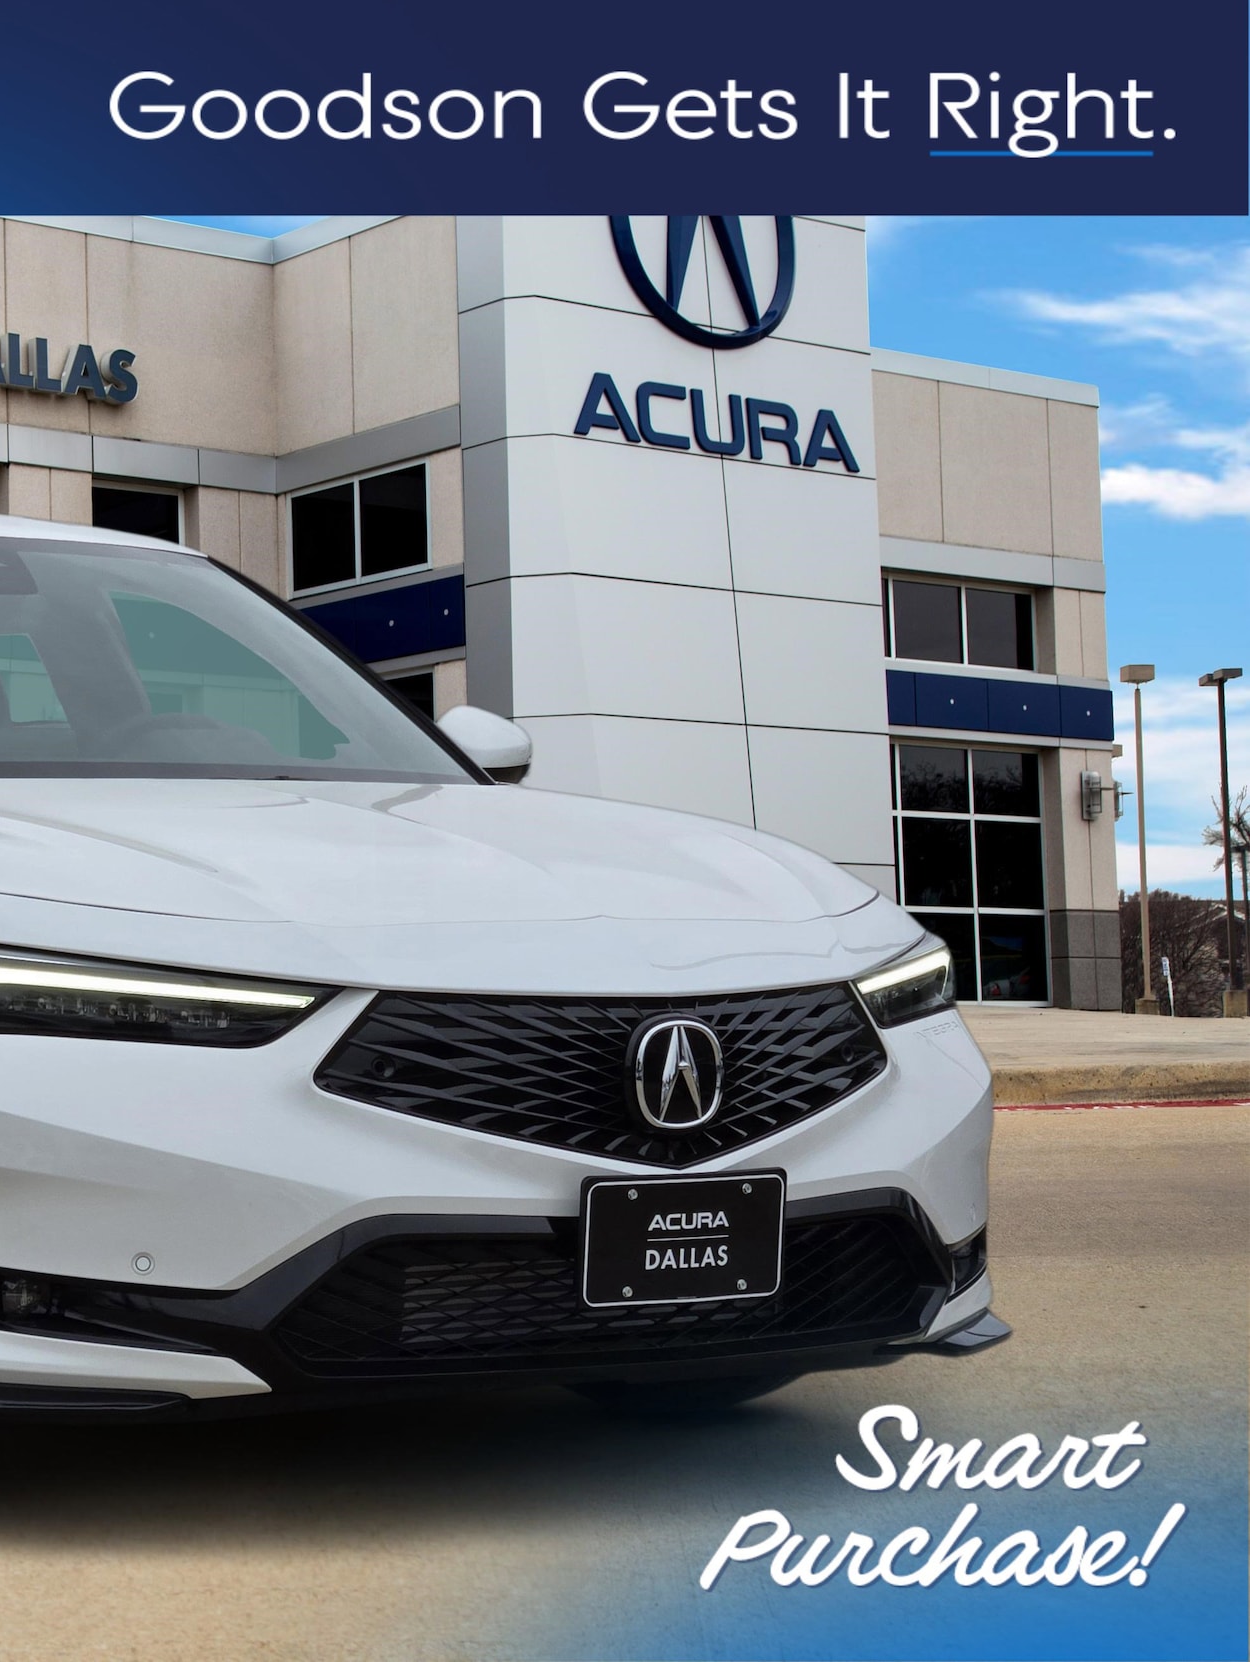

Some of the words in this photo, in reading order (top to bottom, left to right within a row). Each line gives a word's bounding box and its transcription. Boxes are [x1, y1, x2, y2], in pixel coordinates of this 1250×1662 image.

[573, 371, 861, 473] ACURA
[647, 1210, 730, 1232] ACURA
[644, 1245, 729, 1271] DALLAS
